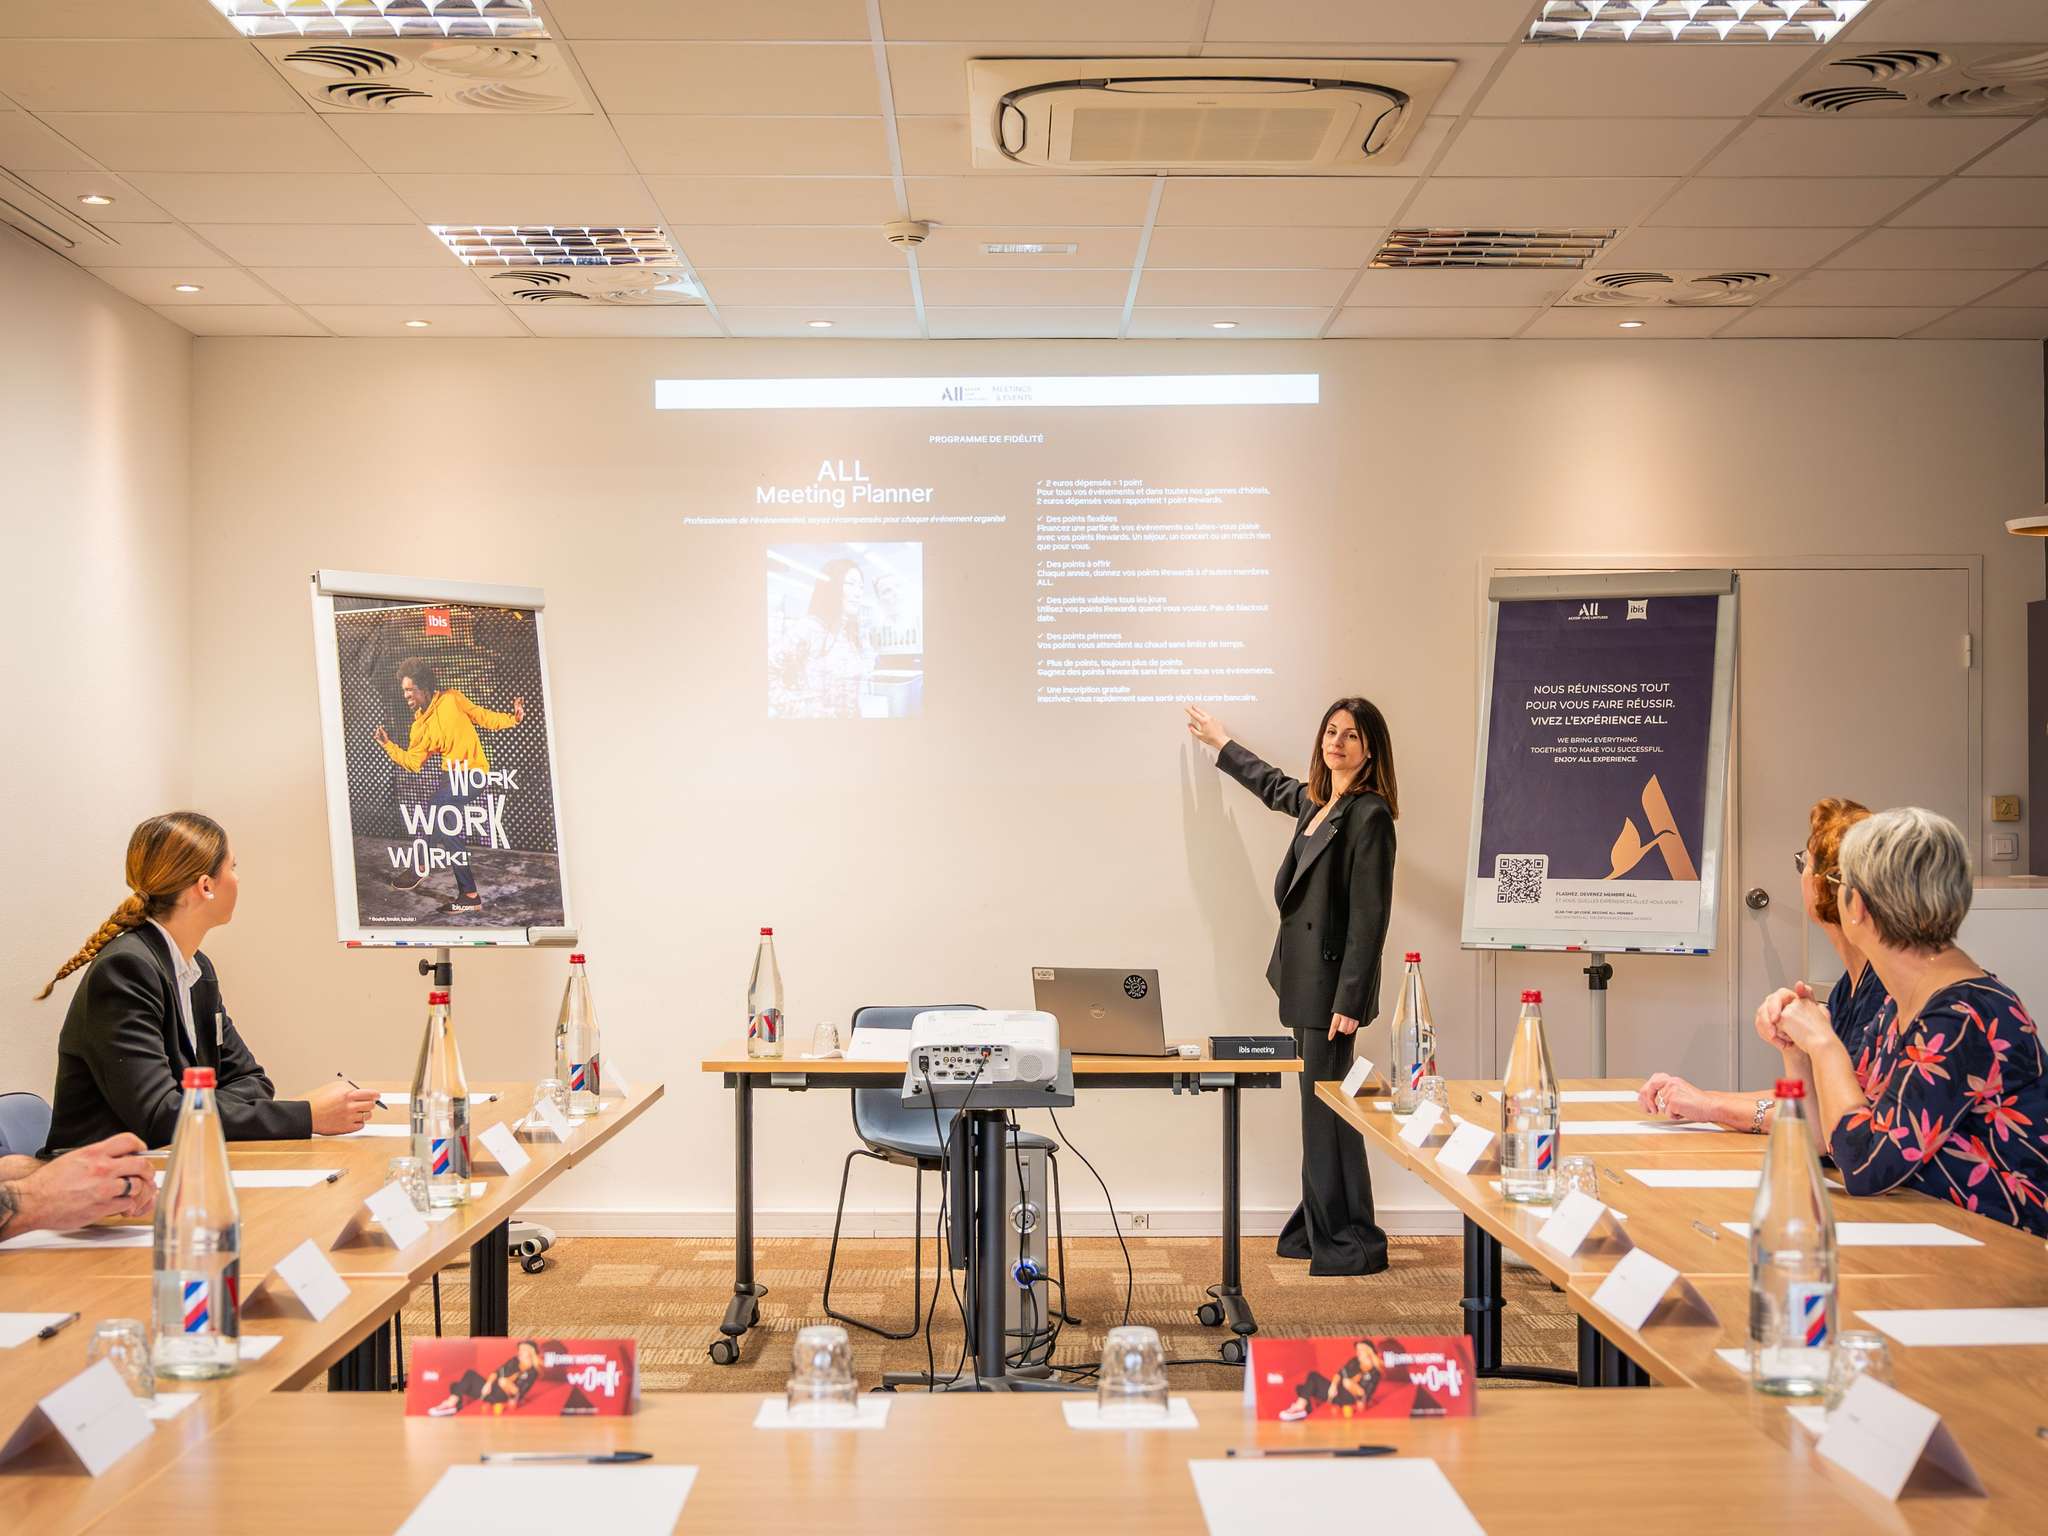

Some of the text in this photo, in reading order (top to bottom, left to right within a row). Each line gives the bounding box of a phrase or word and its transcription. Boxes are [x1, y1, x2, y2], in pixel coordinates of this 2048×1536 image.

[929, 433, 1044, 443] PROGRAMME DE FIDÉLITÉ
[817, 460, 870, 481] ALL
[1075, 480, 1112, 488] dépensés
[1124, 480, 1144, 488] point
[756, 484, 934, 508] Meeting Planner
[1062, 515, 1086, 524] points
[1072, 534, 1095, 542] points
[1062, 561, 1086, 569] points
[1037, 570, 1066, 578] Chaque
[1137, 569, 1160, 578] points
[1062, 596, 1086, 605] points
[1080, 605, 1103, 614] points
[1579, 602, 1598, 616] All
[428, 614, 448, 627] ibis
[1062, 633, 1086, 642] points
[1052, 641, 1076, 650] points
[1082, 669, 1106, 677] points
[1534, 683, 1670, 694] NOUS RÉUNISSONS TOUT
[1526, 698, 1675, 710] POUR VOUS FAIRE RÉUSSIR.
[1531, 716, 1562, 726] VIVEZ
[1644, 715, 1668, 724] ALL.
[448, 758, 519, 796] WORK
[400, 794, 510, 850] WORK
